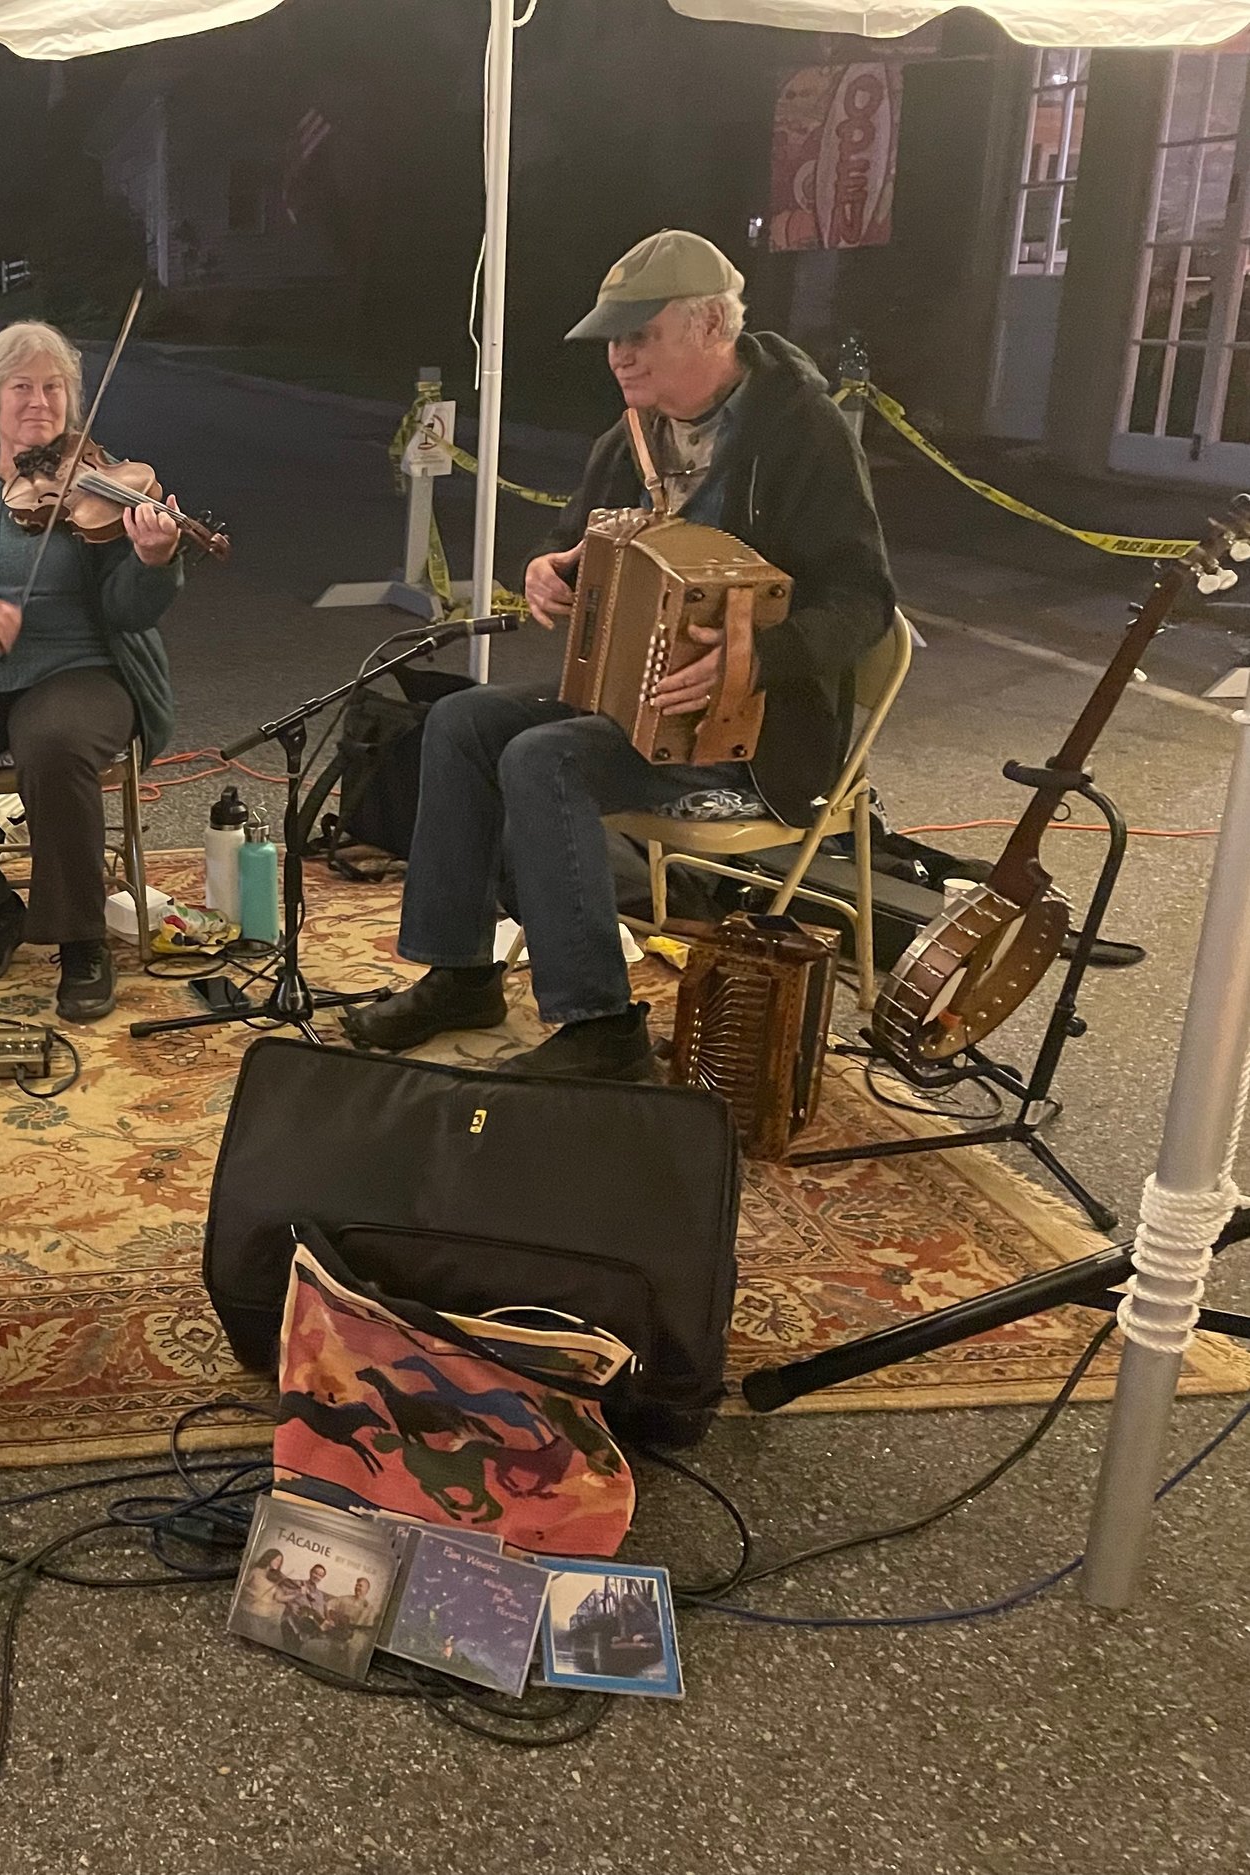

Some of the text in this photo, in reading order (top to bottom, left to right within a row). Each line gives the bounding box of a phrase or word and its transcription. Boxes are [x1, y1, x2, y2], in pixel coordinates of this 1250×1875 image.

[833, 74, 884, 244] OPEN
[1112, 540, 1142, 553] POLICE
[465, 1554, 501, 1575] Weeks
